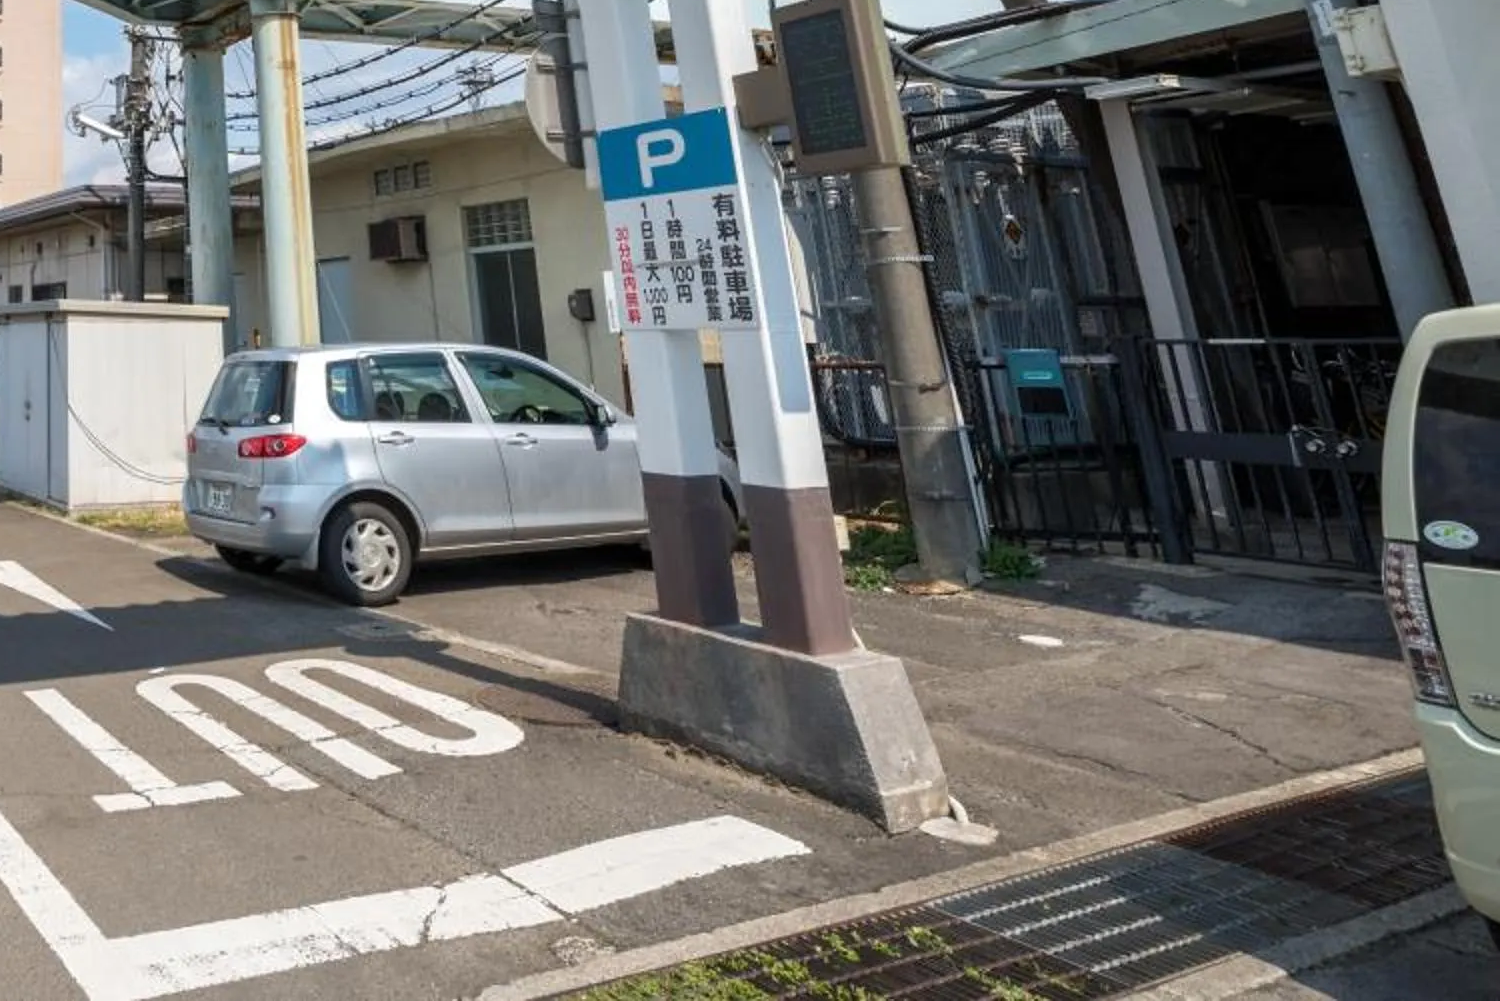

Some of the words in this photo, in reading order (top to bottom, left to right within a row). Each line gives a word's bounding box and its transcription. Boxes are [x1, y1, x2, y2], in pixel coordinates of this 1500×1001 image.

[636, 128, 685, 188] P
[712, 193, 753, 322] 有料駐車場
